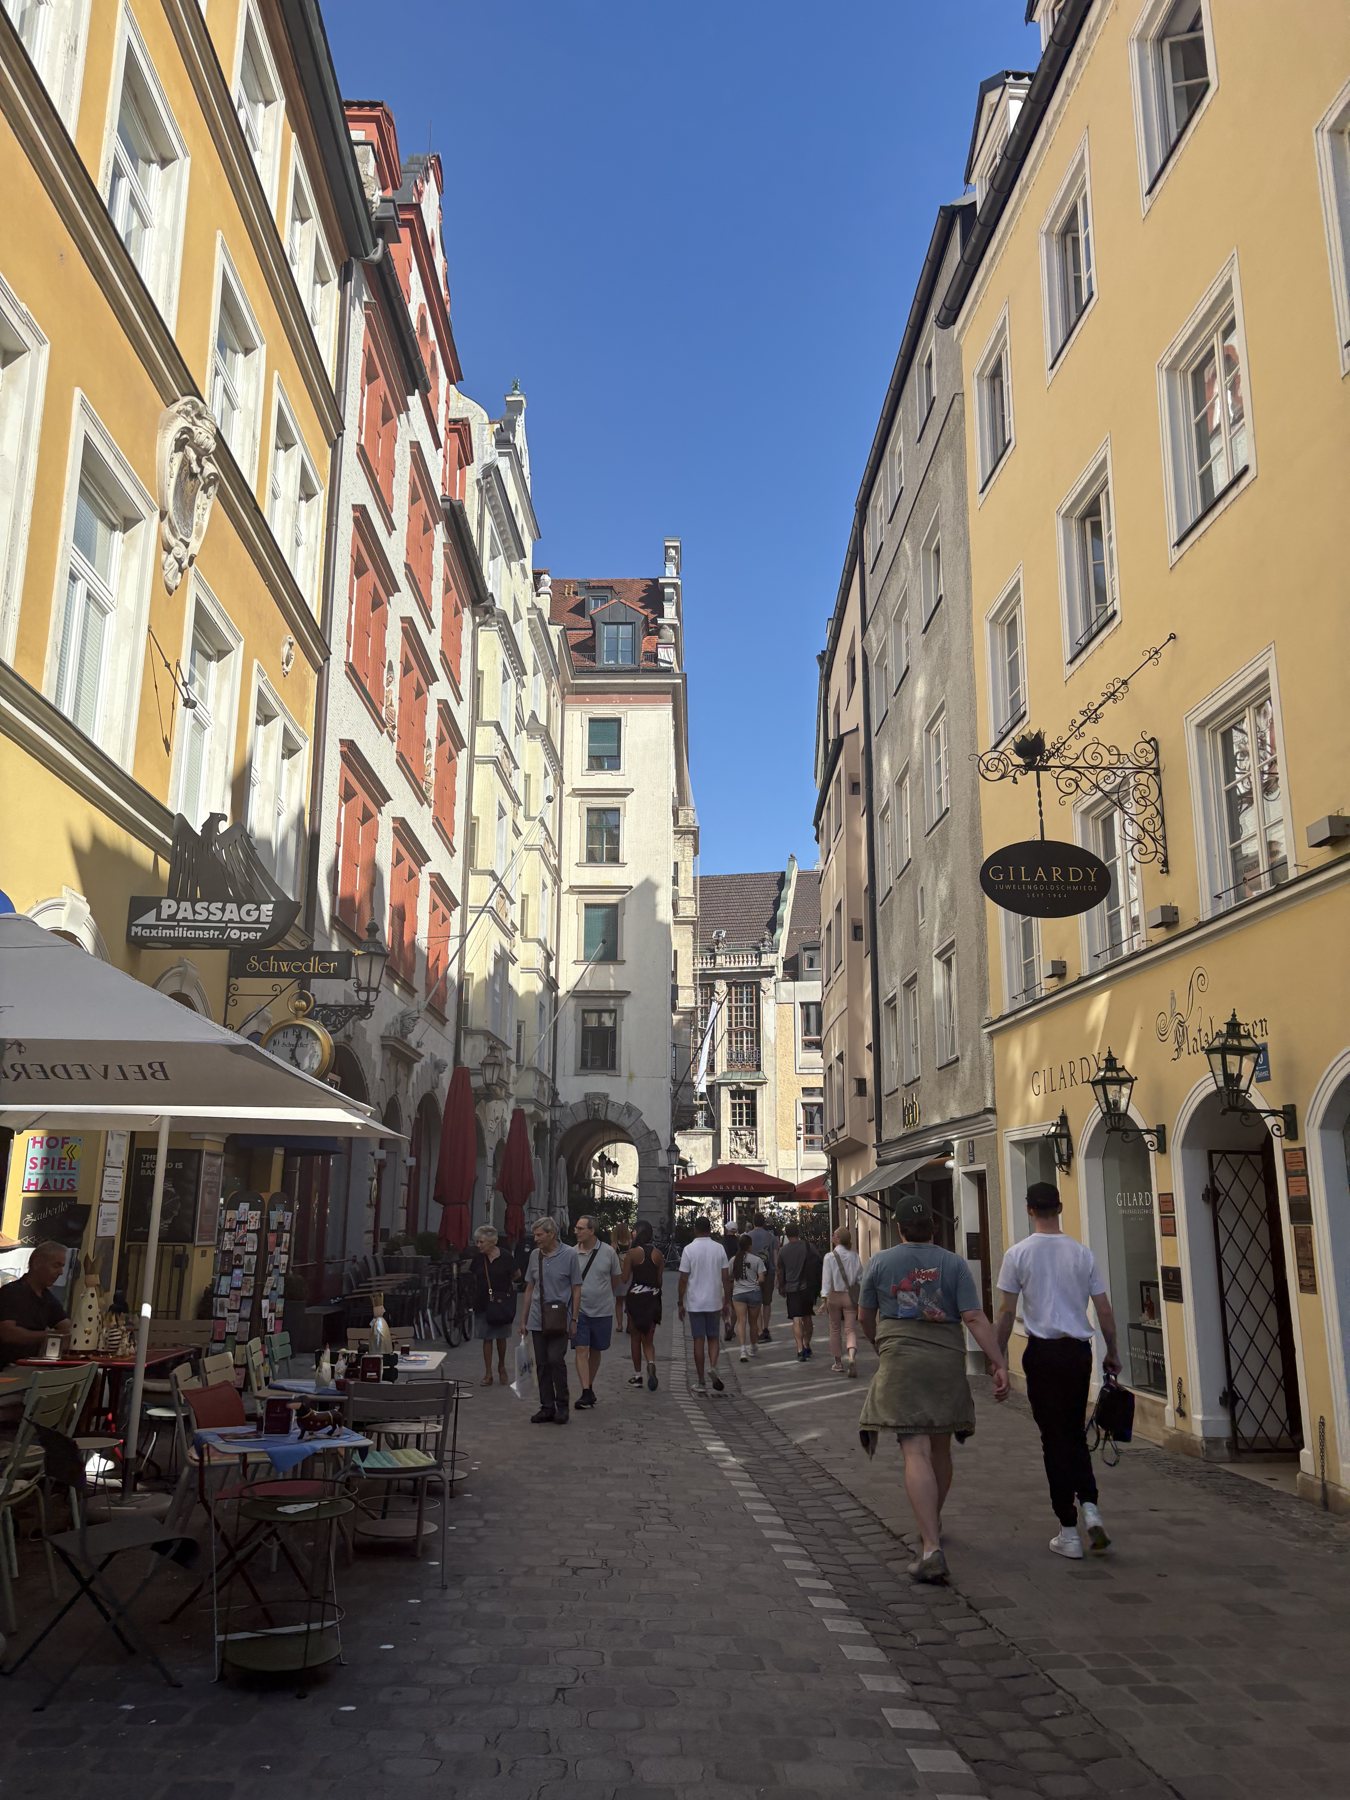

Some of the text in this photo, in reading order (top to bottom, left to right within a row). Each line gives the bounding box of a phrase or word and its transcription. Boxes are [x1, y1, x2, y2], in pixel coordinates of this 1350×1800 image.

[988, 865, 1099, 882] GILARDY
[160, 899, 274, 922] PASSAGE
[131, 926, 262, 941] Maximilianstr./Oper
[246, 955, 338, 974] Schwedler
[31, 1136, 71, 1149] HOF
[29, 1157, 77, 1170] SPIEL
[25, 1178, 76, 1191] HAUS
